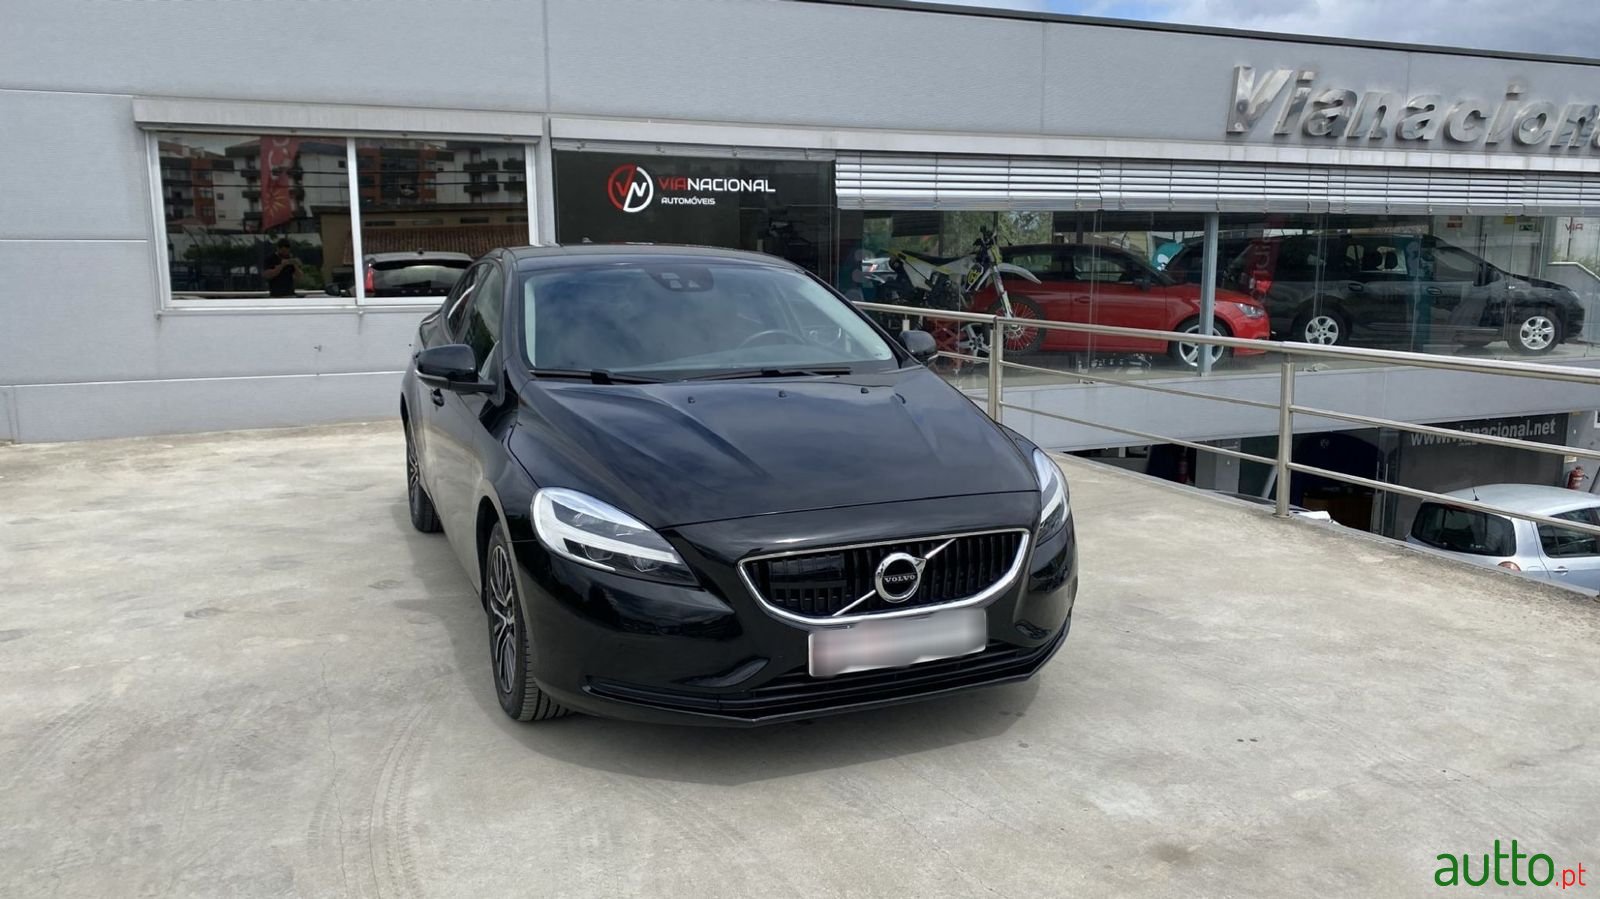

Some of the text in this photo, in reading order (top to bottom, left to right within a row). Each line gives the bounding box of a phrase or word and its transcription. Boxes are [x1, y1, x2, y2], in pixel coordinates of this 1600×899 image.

[1226, 65, 1600, 149] Vianacion
[661, 196, 716, 205] AUTOMÓVEIS
[1410, 417, 1556, 446] www.acional.net
[884, 574, 916, 583] VOLVO
